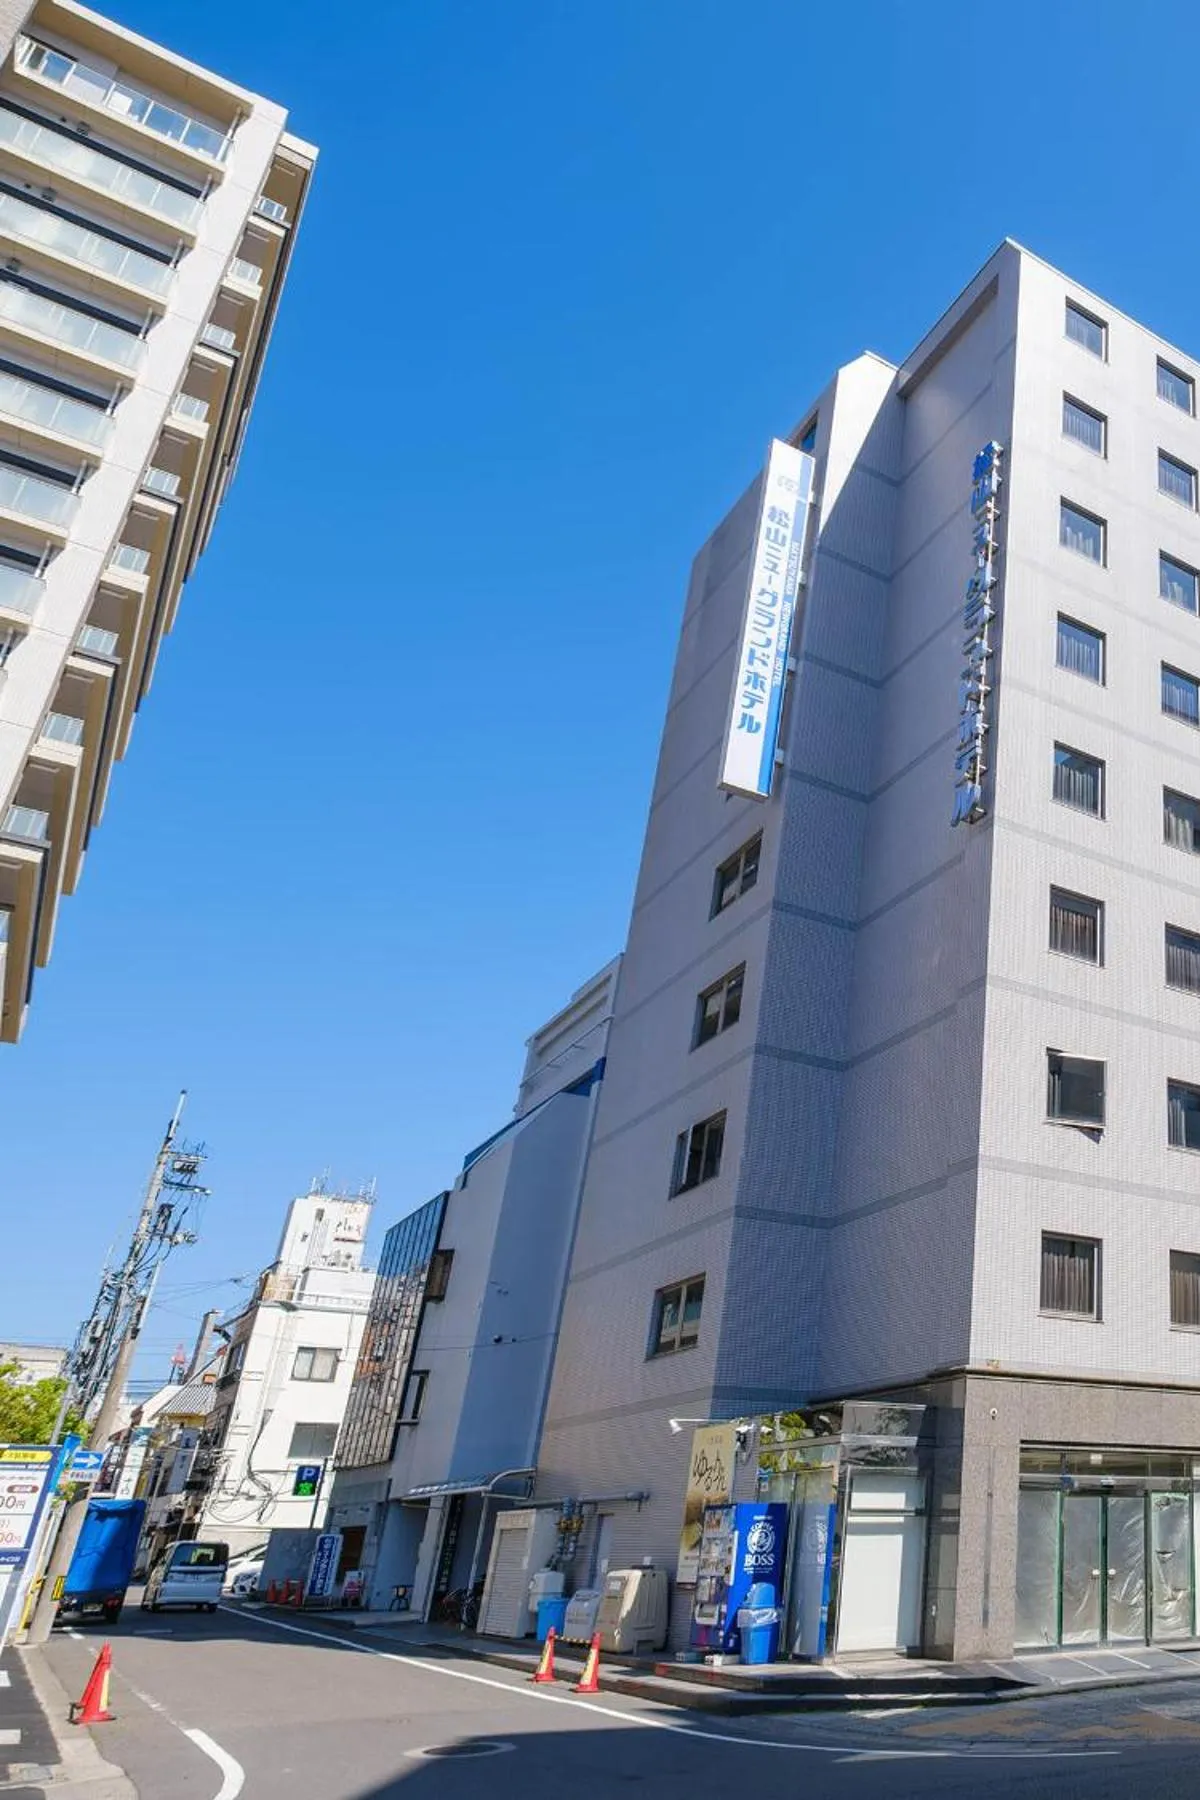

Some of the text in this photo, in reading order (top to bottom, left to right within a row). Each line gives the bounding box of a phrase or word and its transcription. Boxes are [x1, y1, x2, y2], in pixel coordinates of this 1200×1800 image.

[738, 505, 791, 734] 松山ニューグランドホテル
[302, 1468, 316, 1481] P
[744, 1553, 775, 1566] BOSS
